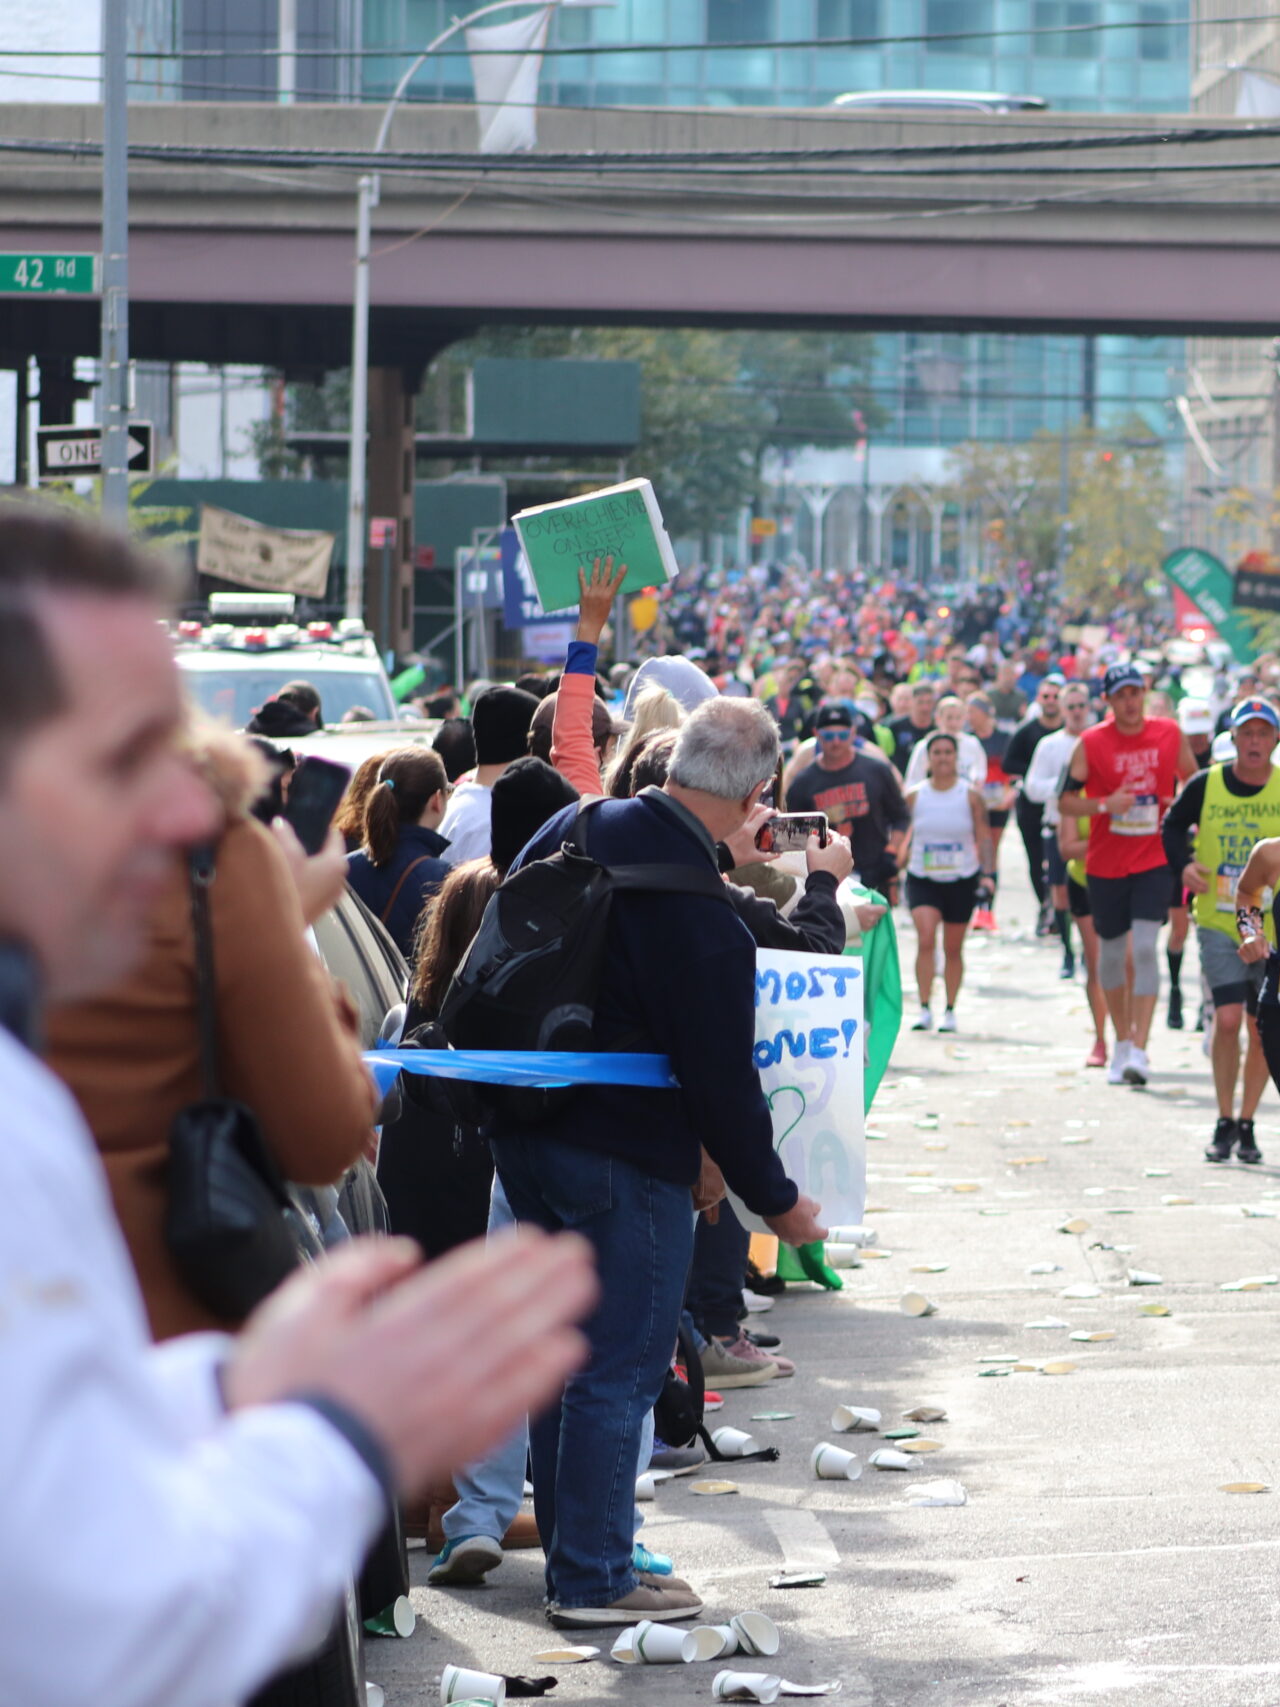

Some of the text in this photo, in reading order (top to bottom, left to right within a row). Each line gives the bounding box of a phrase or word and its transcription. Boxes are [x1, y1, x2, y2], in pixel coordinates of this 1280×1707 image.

[14, 258, 76, 288] 42 Rd
[60, 443, 102, 463] ONE
[553, 534, 582, 555] ON
[574, 542, 625, 565] TODAY
[1208, 804, 1280, 820] JONATHAN
